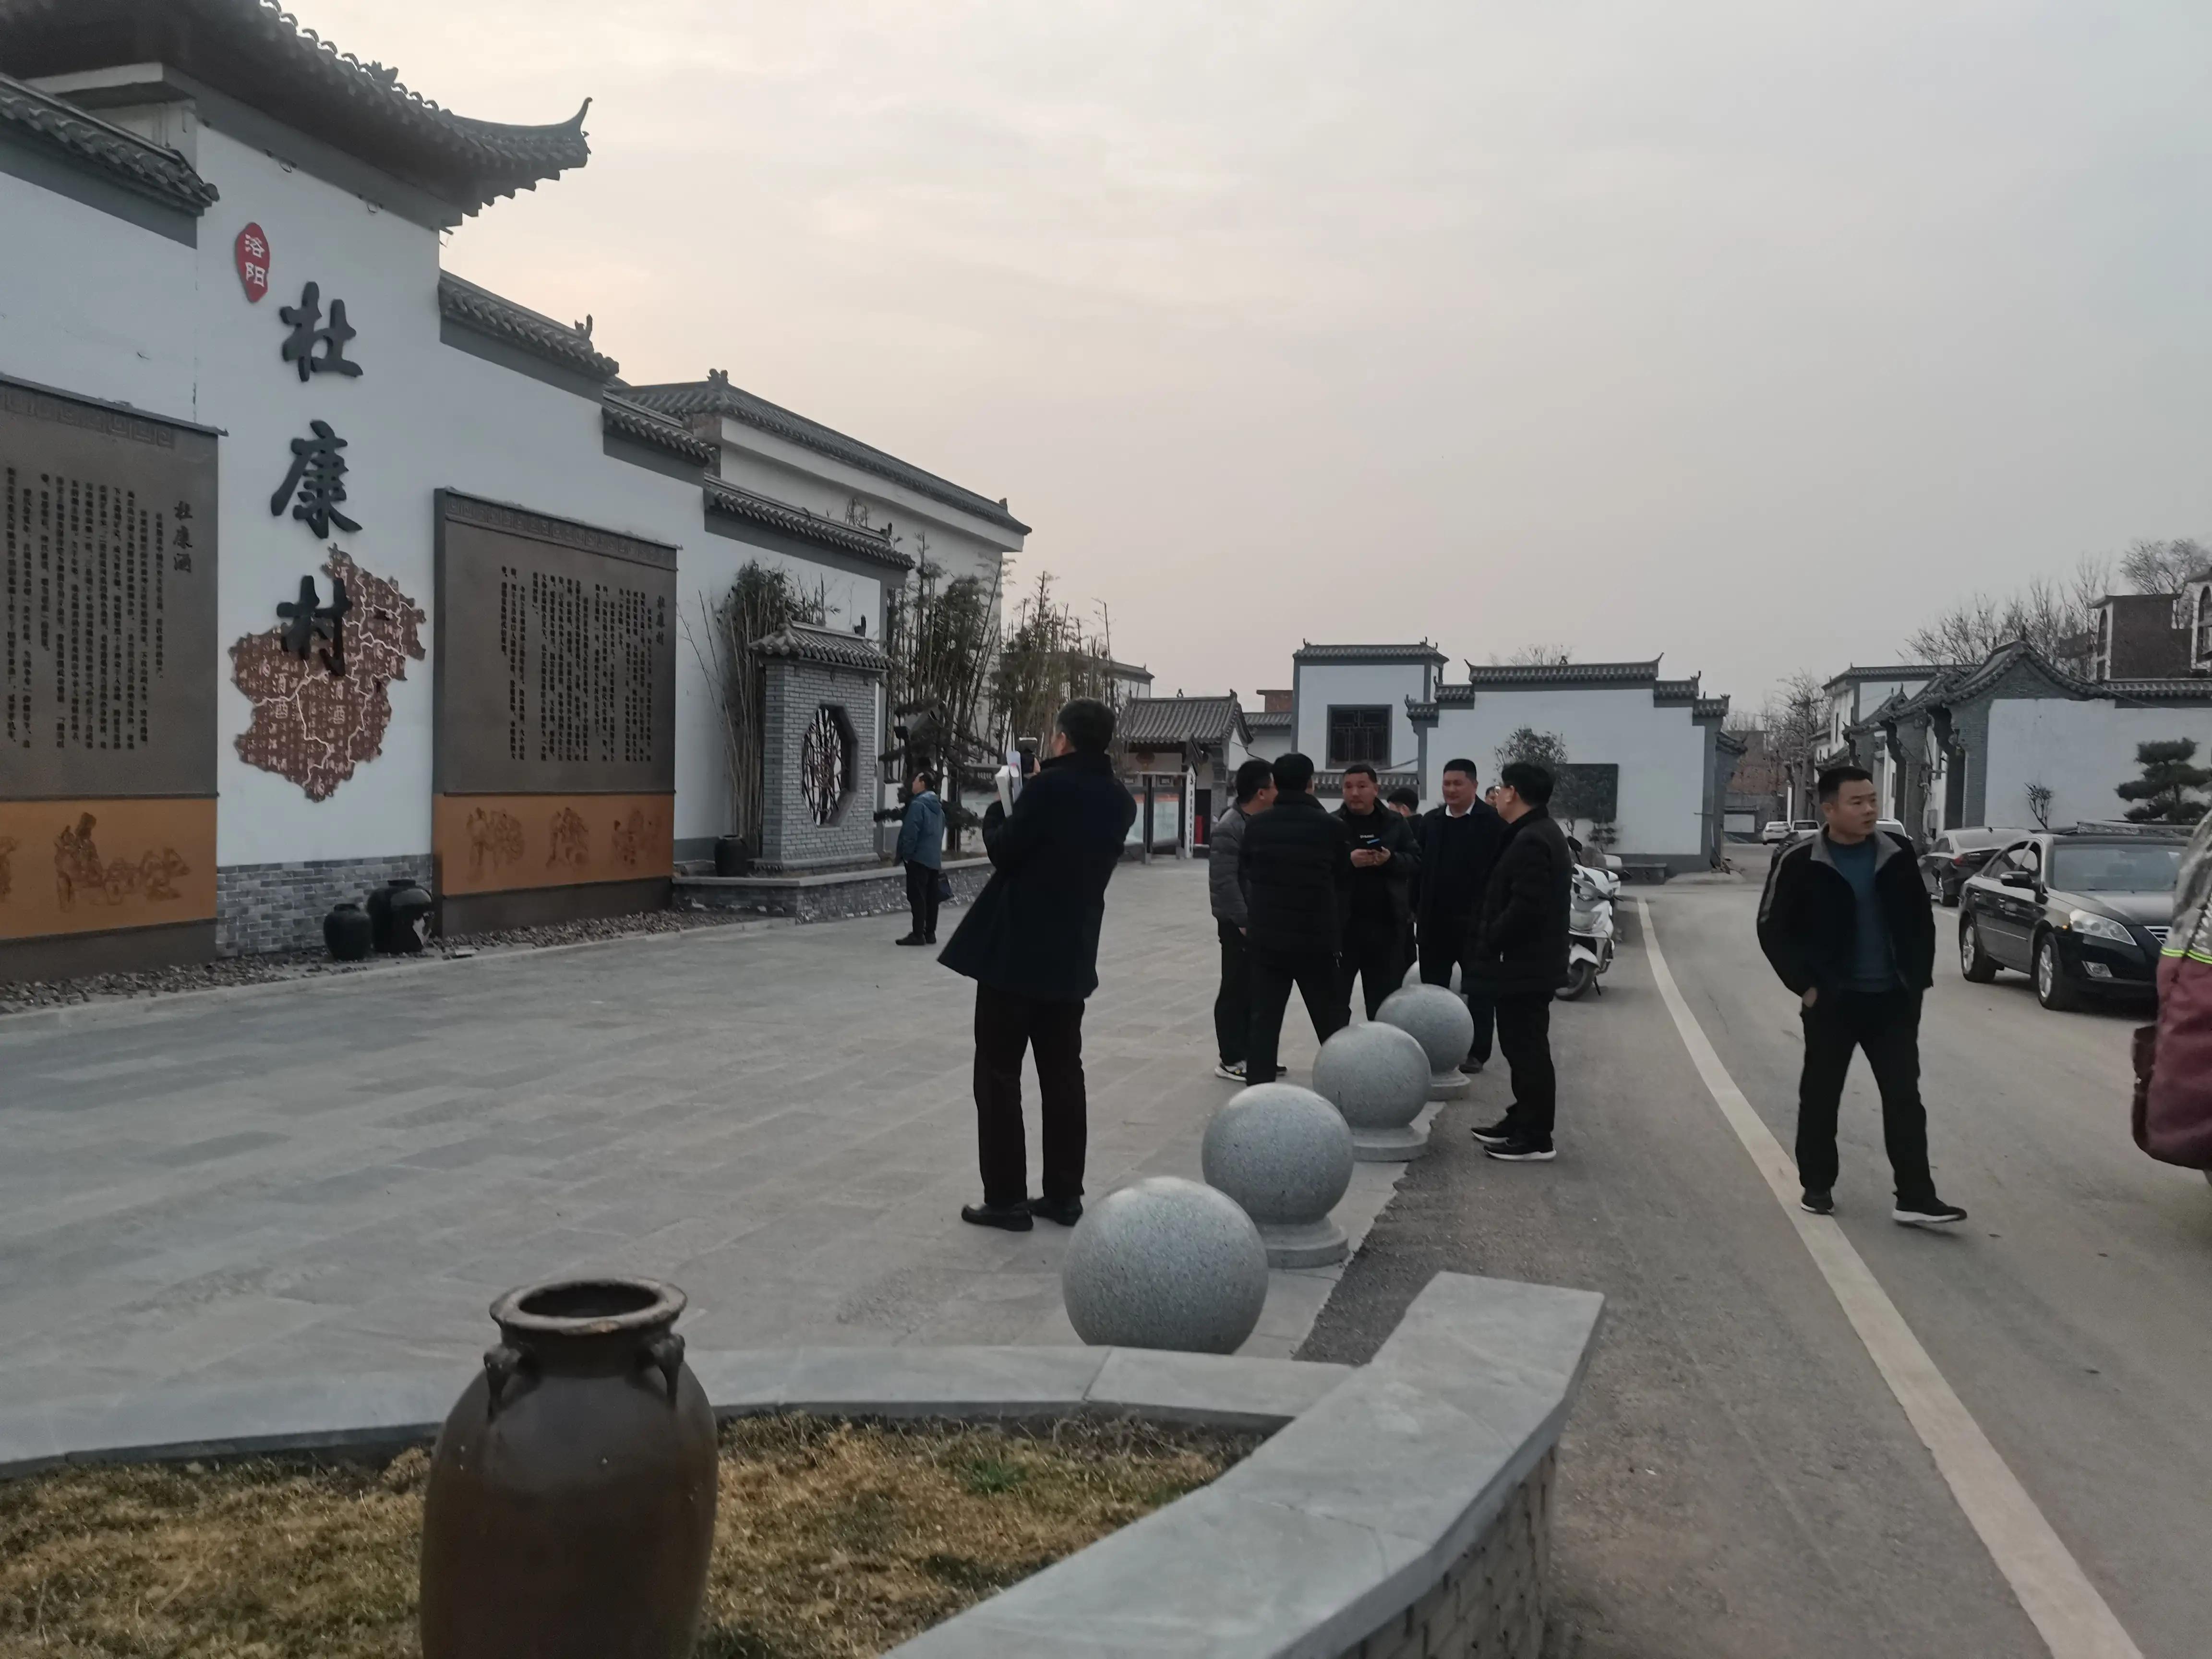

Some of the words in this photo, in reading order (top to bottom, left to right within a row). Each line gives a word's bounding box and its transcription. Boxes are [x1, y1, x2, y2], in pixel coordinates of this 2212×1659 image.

[244, 233, 265, 288] 洛阳
[271, 281, 363, 676] 杜康村
